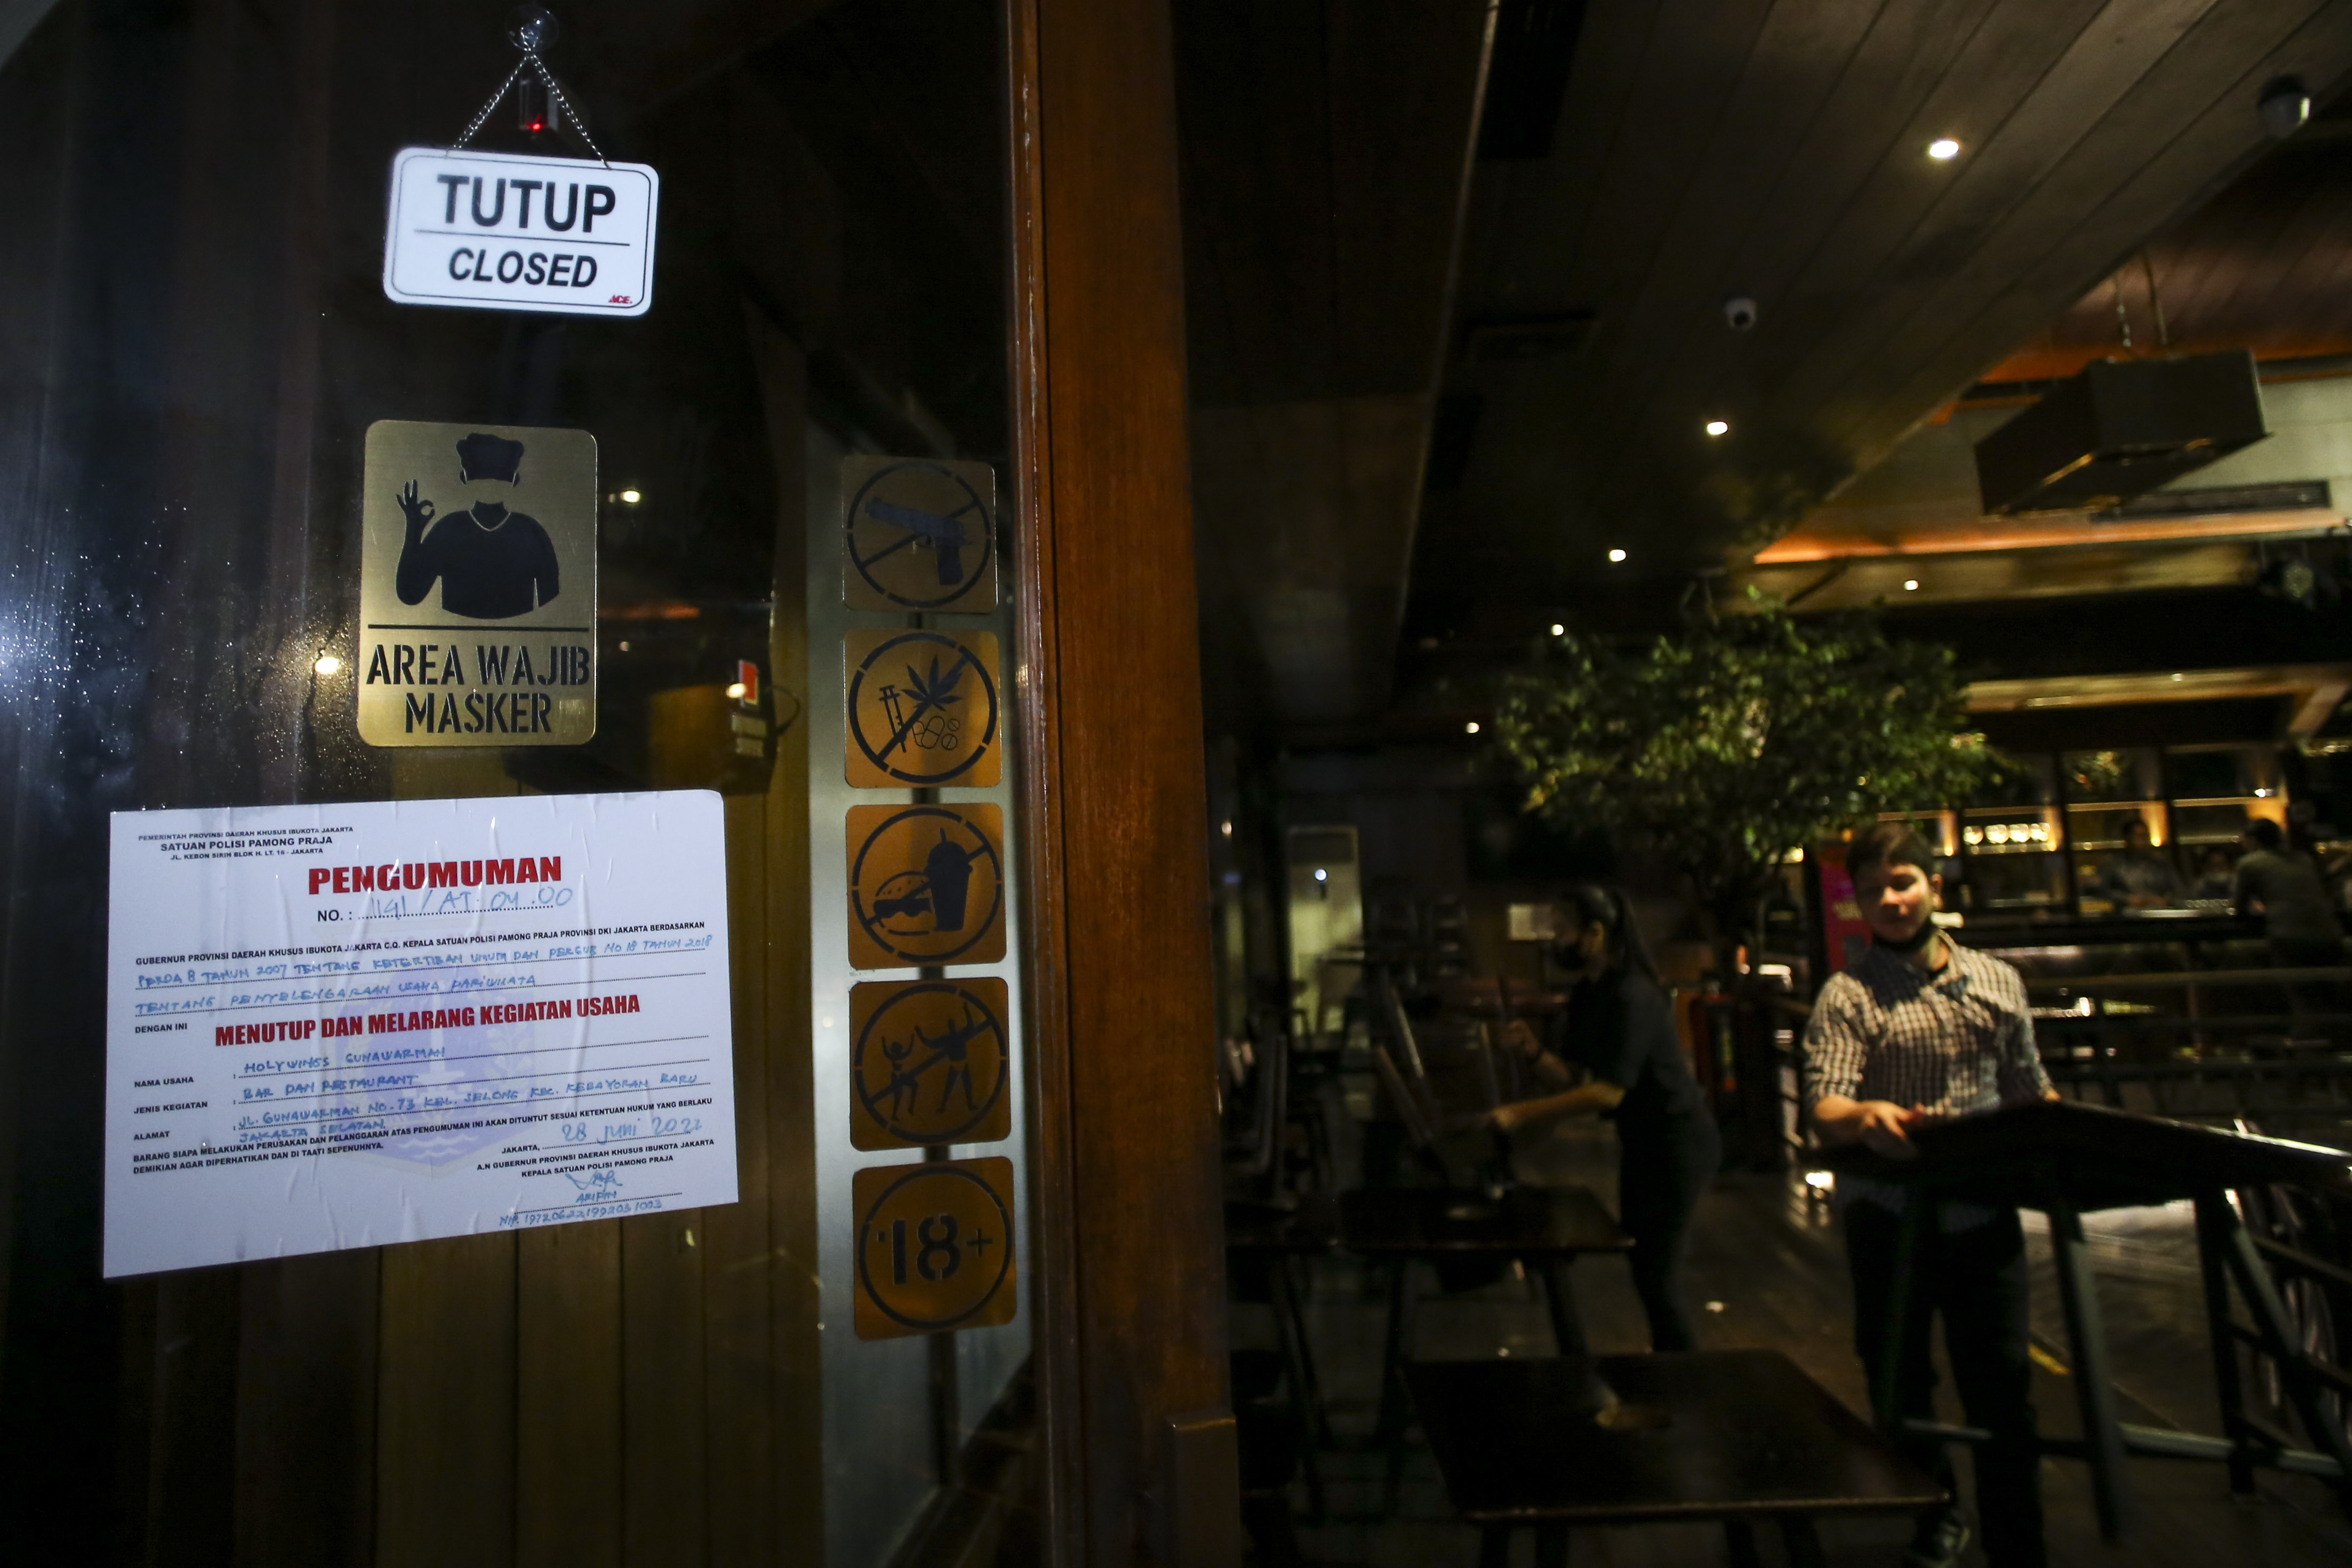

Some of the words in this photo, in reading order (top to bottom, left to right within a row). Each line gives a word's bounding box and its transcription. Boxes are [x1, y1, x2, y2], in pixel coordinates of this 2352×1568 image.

[437, 174, 615, 233] TUTUP
[449, 248, 597, 287] CLOSED
[366, 644, 464, 685] AREA
[476, 645, 590, 685] WAJIB
[405, 693, 552, 733] MASKER
[161, 842, 205, 851] SATUAN
[209, 840, 245, 849] POLISI
[249, 838, 294, 847] PAMONG
[299, 836, 332, 845] PRAJA
[309, 856, 561, 894] PENGUMUMAN
[136, 955, 186, 965] GUBERNUR
[188, 952, 228, 962] PROVINSI
[232, 950, 266, 959] DAERAH
[269, 947, 303, 957] KHUSUS
[306, 945, 342, 954] IBUKOTA
[345, 943, 381, 952] JAKARTA
[403, 939, 433, 947] KEPALA
[437, 937, 468, 945] SATUAN
[470, 935, 495, 943] POLISI
[498, 933, 531, 942] PAMONG
[533, 931, 558, 939] PRAJA
[561, 929, 596, 937] PROVINSI
[614, 925, 648, 934] JAKARTA
[650, 921, 705, 931] BERDASARKAN
[256, 964, 287, 978] 2007
[685, 935, 712, 947] 2018
[135, 1023, 172, 1034] DENGAN
[216, 1020, 316, 1046] MENUTUP
[322, 1015, 363, 1038] DAN
[368, 1007, 475, 1034] MELARANG
[480, 999, 572, 1025] KEGIATAN
[577, 995, 640, 1018] USAHA
[134, 1080, 160, 1088] NAMA
[163, 1076, 194, 1085] USAHA
[134, 1106, 160, 1114] JENIS
[163, 1102, 208, 1111] KEGIATAN
[133, 1152, 170, 1162] BARANG
[173, 1150, 197, 1158] SIAPA
[201, 1144, 254, 1155] MELAKUKAN
[257, 1138, 307, 1150] PERUSAKAN
[329, 1131, 388, 1142] PELANGGARAN
[414, 1122, 470, 1134] PENGUMUMAN
[509, 1114, 547, 1125] DITUNTUT
[551, 1112, 577, 1120] SESUAI
[580, 1107, 624, 1117] KETENTUAN
[627, 1104, 654, 1112] HUKUM
[656, 1102, 676, 1110] YANG
[678, 1098, 712, 1107] BERLAKU
[134, 1131, 170, 1140] ALAMAT
[133, 1164, 177, 1174] DEMIKIAN
[180, 1161, 203, 1169] AGAR
[206, 1154, 269, 1166] DIPERHATIKAN
[302, 1148, 324, 1156] TAATI
[327, 1143, 383, 1154] SEPENUHNYA.
[493, 1159, 537, 1168] GUBERNUR
[539, 1154, 576, 1164] PROVINSI
[578, 1151, 609, 1159] DAERAH
[612, 1147, 643, 1156] KHUSUS
[645, 1144, 678, 1152] IBUKOTA
[681, 1139, 714, 1148] JAKARTA
[502, 1144, 540, 1154] JAKARTA,
[522, 1168, 552, 1177] KEPALA
[554, 1165, 585, 1174] SATUAN
[587, 1161, 612, 1170] POLISI
[615, 1158, 647, 1167] PAMONG
[649, 1155, 674, 1163] PRAJA
